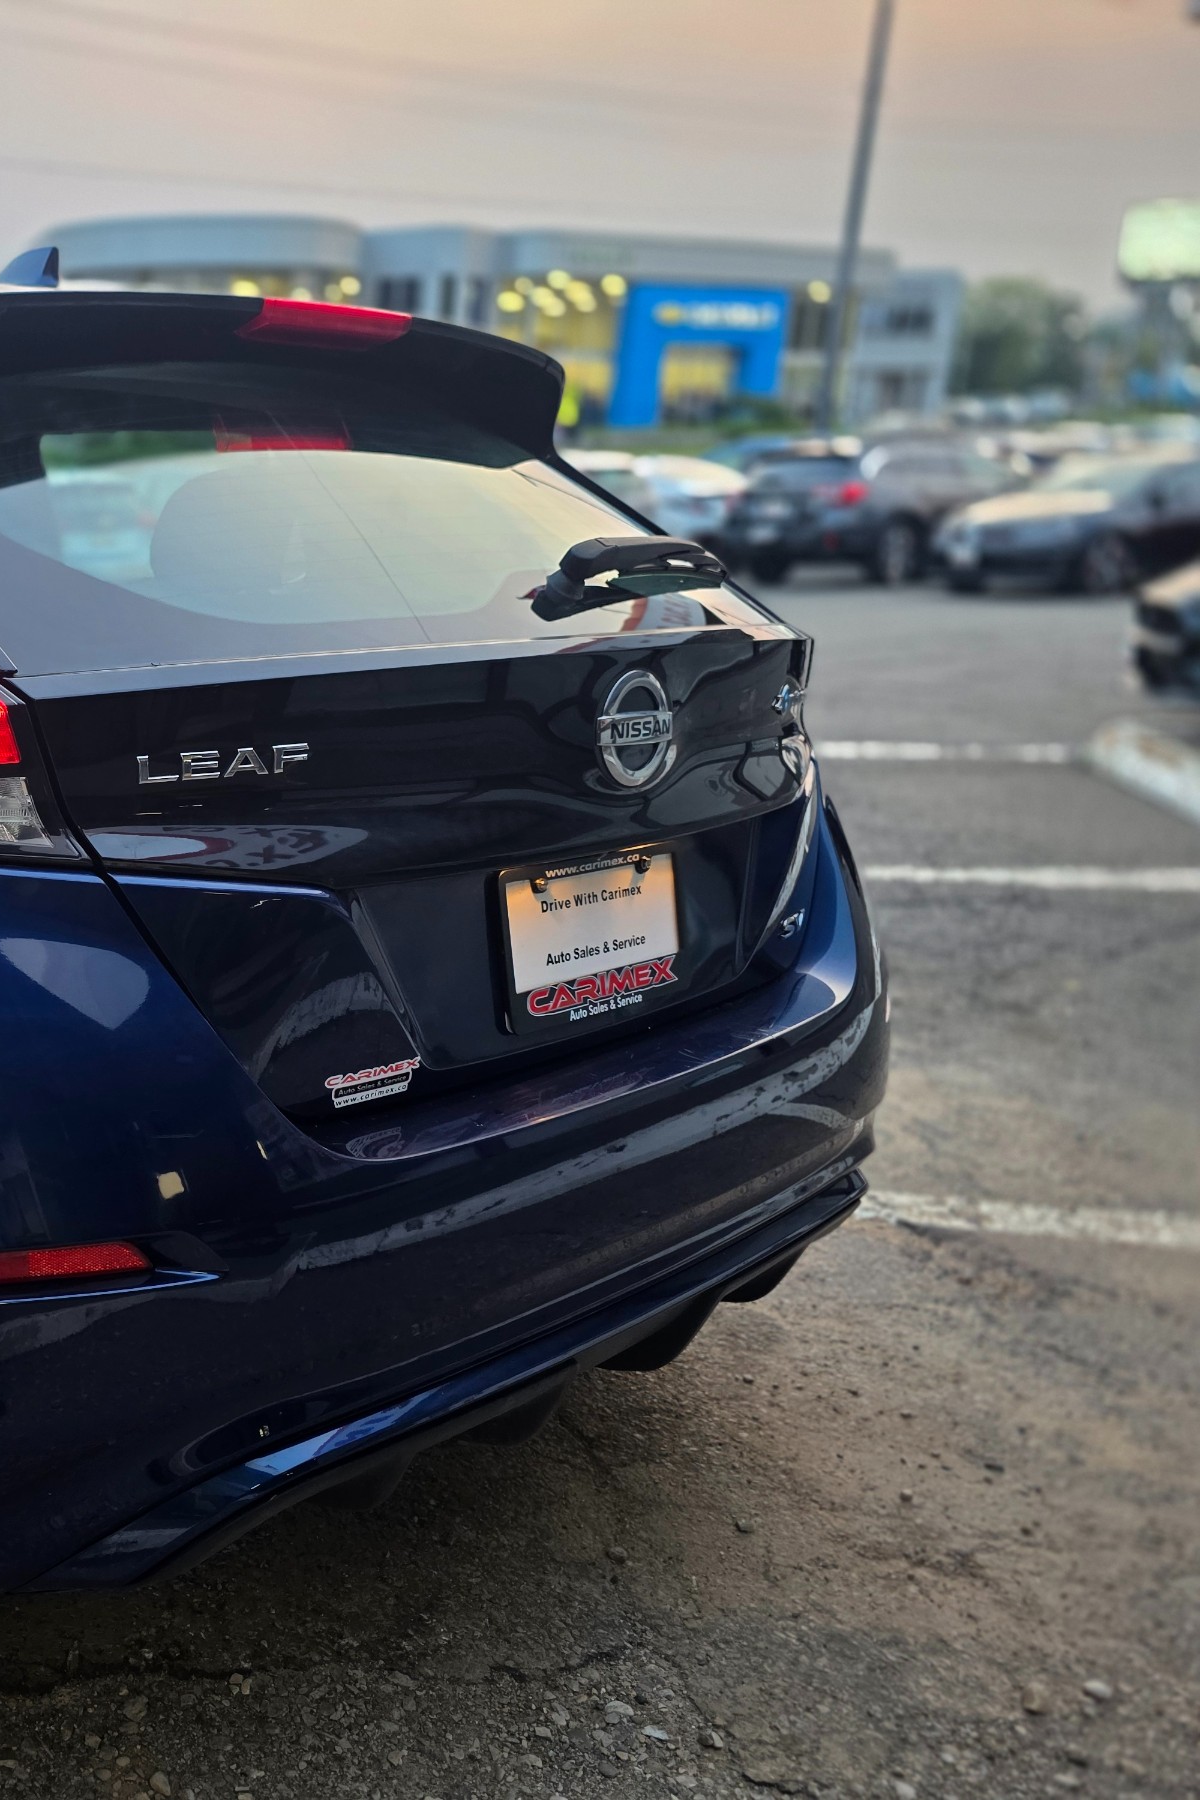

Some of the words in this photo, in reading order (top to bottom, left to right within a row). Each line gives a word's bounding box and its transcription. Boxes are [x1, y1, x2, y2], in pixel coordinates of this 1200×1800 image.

[610, 718, 670, 739] NISSAN
[136, 742, 309, 785] LEAF
[545, 853, 640, 878] www.carimex.ca
[541, 898, 571, 914] Drive
[573, 890, 599, 907] With
[601, 885, 642, 901] Carimex
[546, 947, 571, 966] Auto
[573, 942, 600, 960] Sales
[603, 942, 610, 953] &
[613, 934, 646, 951] Service
[527, 955, 677, 1016] CARIMEX
[570, 1003, 587, 1022] Auto
[589, 1001, 608, 1015] Sales
[610, 999, 616, 1010] &
[617, 993, 643, 1008] Service
[326, 1058, 419, 1087] CARIMEX
[338, 1088, 355, 1096] Auto
[357, 1083, 375, 1091] Sales
[384, 1075, 407, 1083] Service
